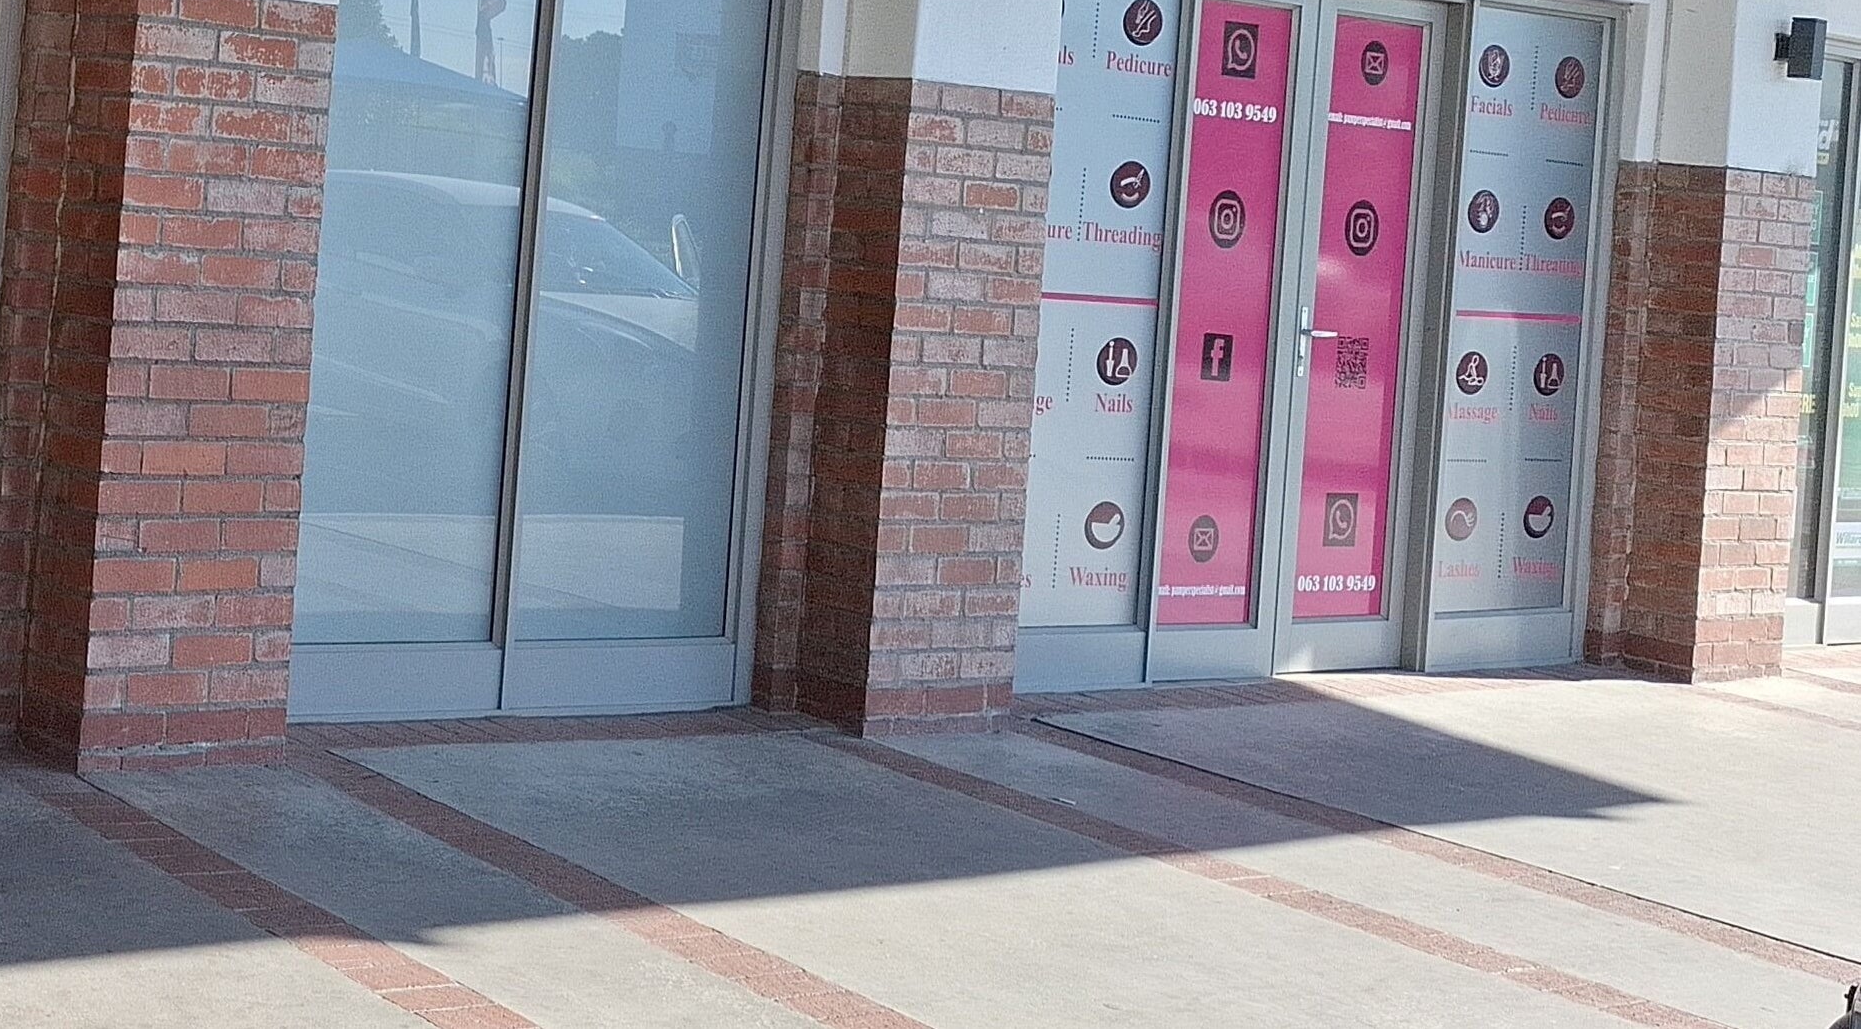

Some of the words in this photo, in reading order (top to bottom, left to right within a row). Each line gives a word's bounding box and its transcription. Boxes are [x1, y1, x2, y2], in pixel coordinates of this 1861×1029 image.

[1106, 50, 1172, 77] Pedicure
[1193, 97, 1217, 117] 063
[1220, 101, 1243, 120] 103
[1245, 104, 1277, 123] 9549
[1470, 95, 1513, 117] Facials
[1083, 221, 1163, 252] Threading
[1460, 250, 1517, 270] Manicure
[1094, 393, 1134, 413] Nails
[1068, 566, 1127, 592] Waxing
[1297, 575, 1320, 592] 063
[1323, 575, 1343, 592] 103
[1346, 575, 1376, 592] 9549
